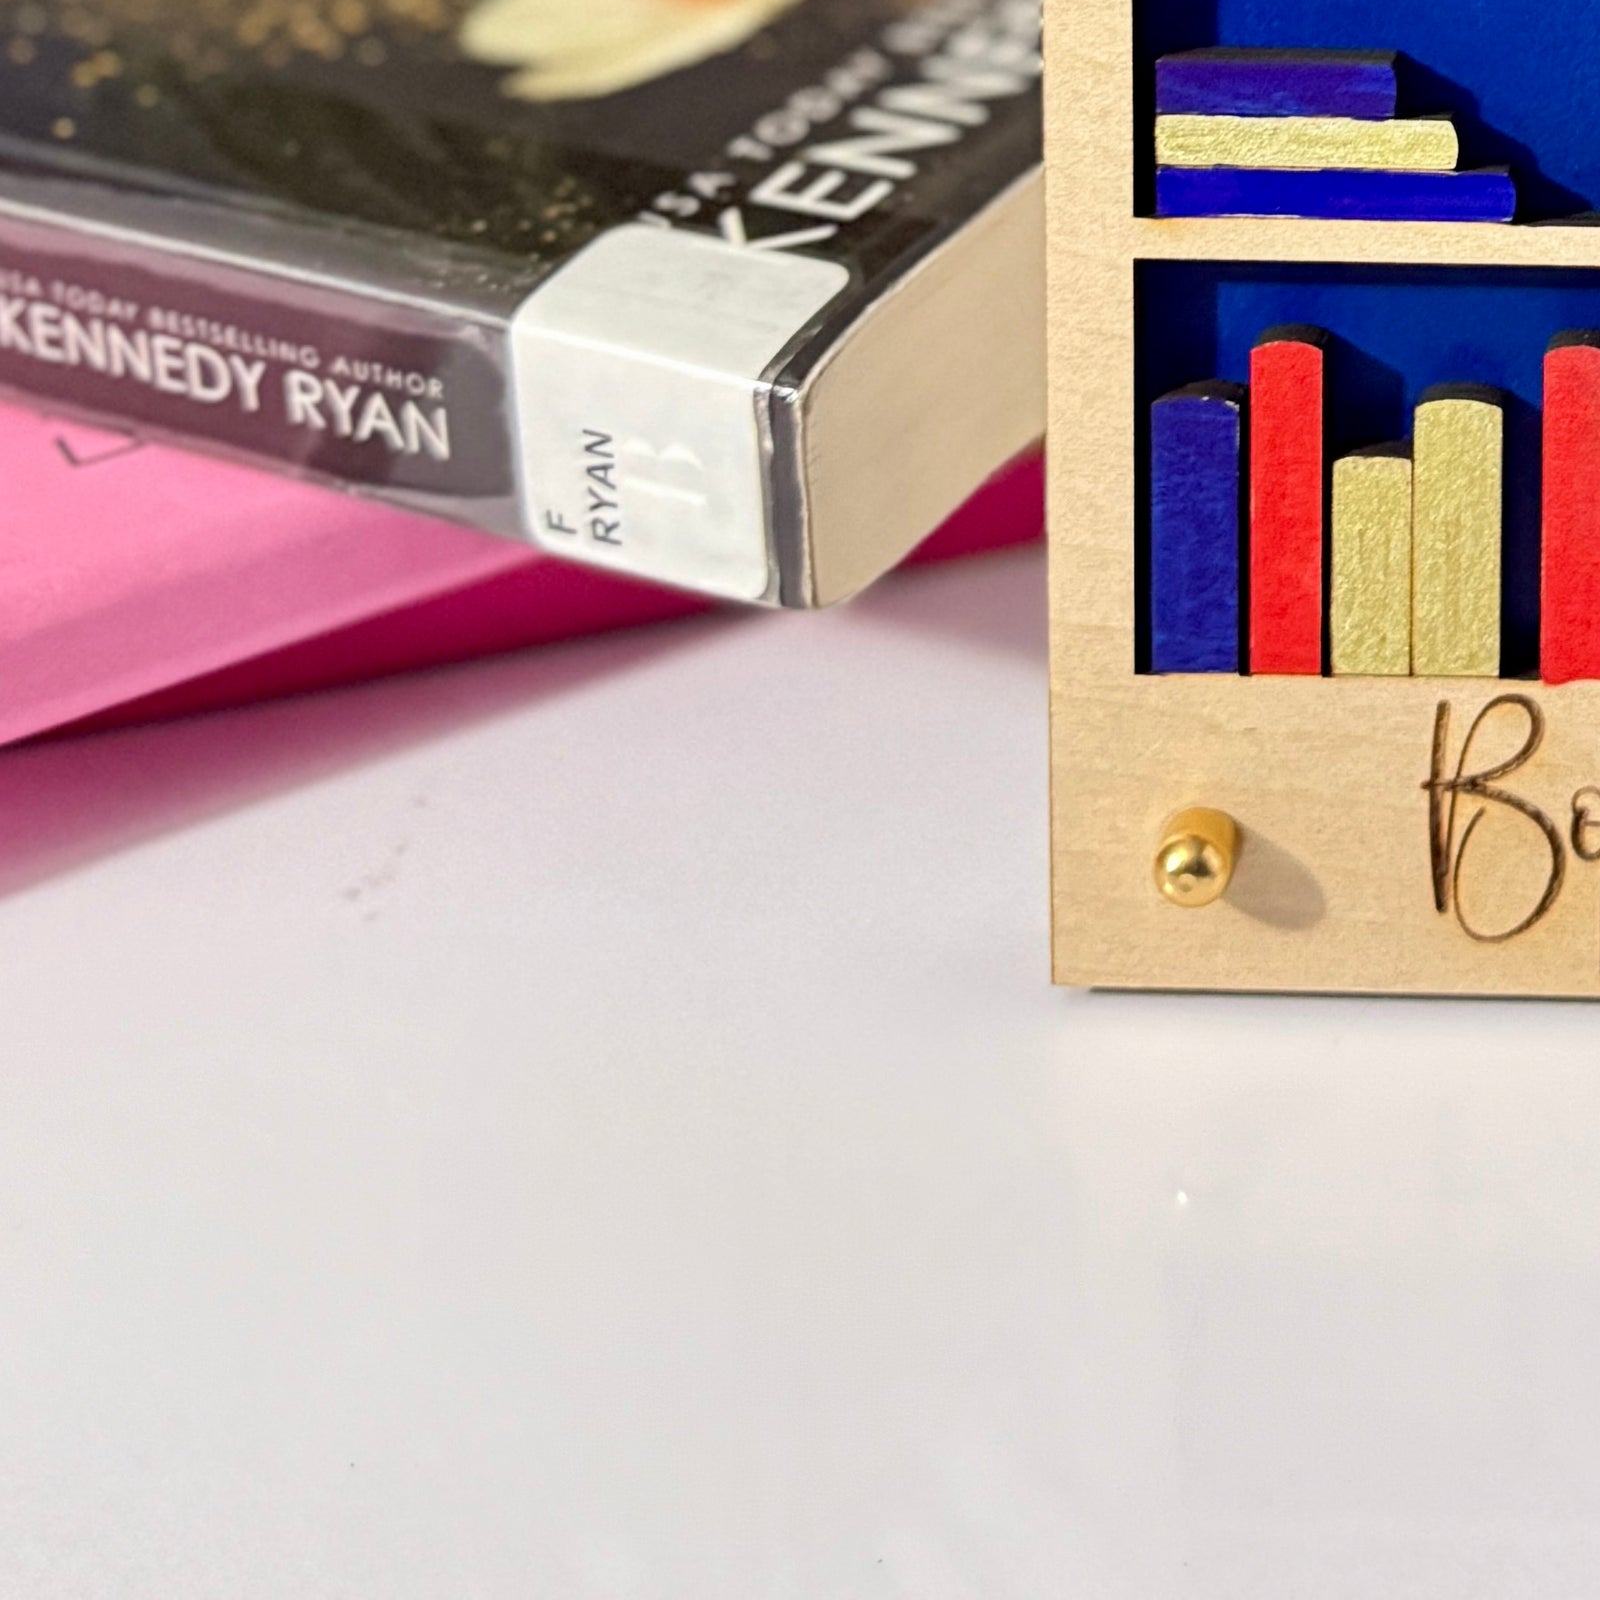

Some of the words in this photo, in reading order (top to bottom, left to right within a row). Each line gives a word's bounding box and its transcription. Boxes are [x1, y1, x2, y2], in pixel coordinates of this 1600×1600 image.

[0, 293, 267, 412] KENNEDY
[283, 368, 450, 460] RYAN
[50, 278, 140, 323] TODAY
[147, 305, 321, 369] BESTSELLING
[329, 356, 445, 399] AUTHOR
[546, 508, 579, 536] F
[581, 428, 624, 547] RYAN
